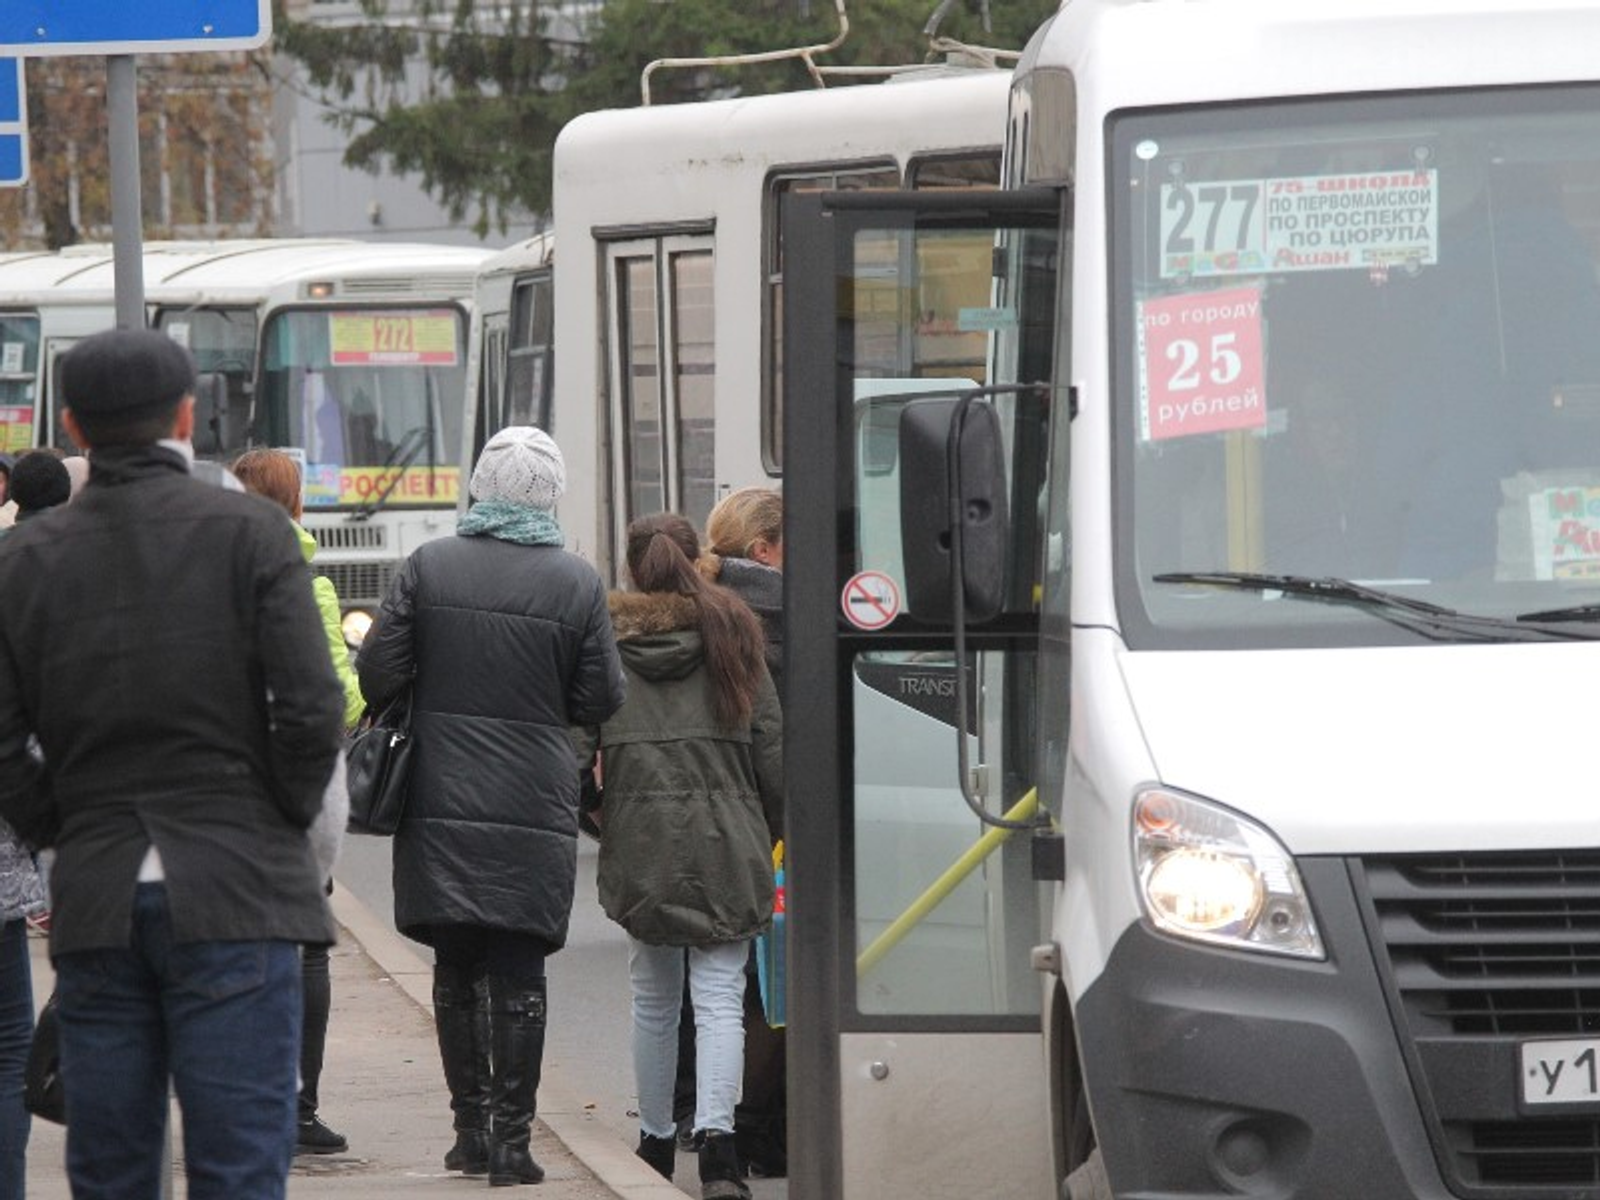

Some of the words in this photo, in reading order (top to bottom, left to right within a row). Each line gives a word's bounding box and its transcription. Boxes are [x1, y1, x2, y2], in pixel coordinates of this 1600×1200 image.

[1269, 194, 1292, 213] ПО
[1166, 184, 1260, 254] 277
[1269, 213, 1298, 231] ПО
[1305, 207, 1429, 229] ПРОСПЕКТУ
[1290, 230, 1322, 247] ПО
[1329, 225, 1430, 247] ЦЮРУПА
[1273, 247, 1350, 267] Ашан
[1145, 312, 1171, 330] по
[1181, 301, 1259, 325] городу
[1165, 331, 1242, 392] 25
[1158, 389, 1259, 425] рублей
